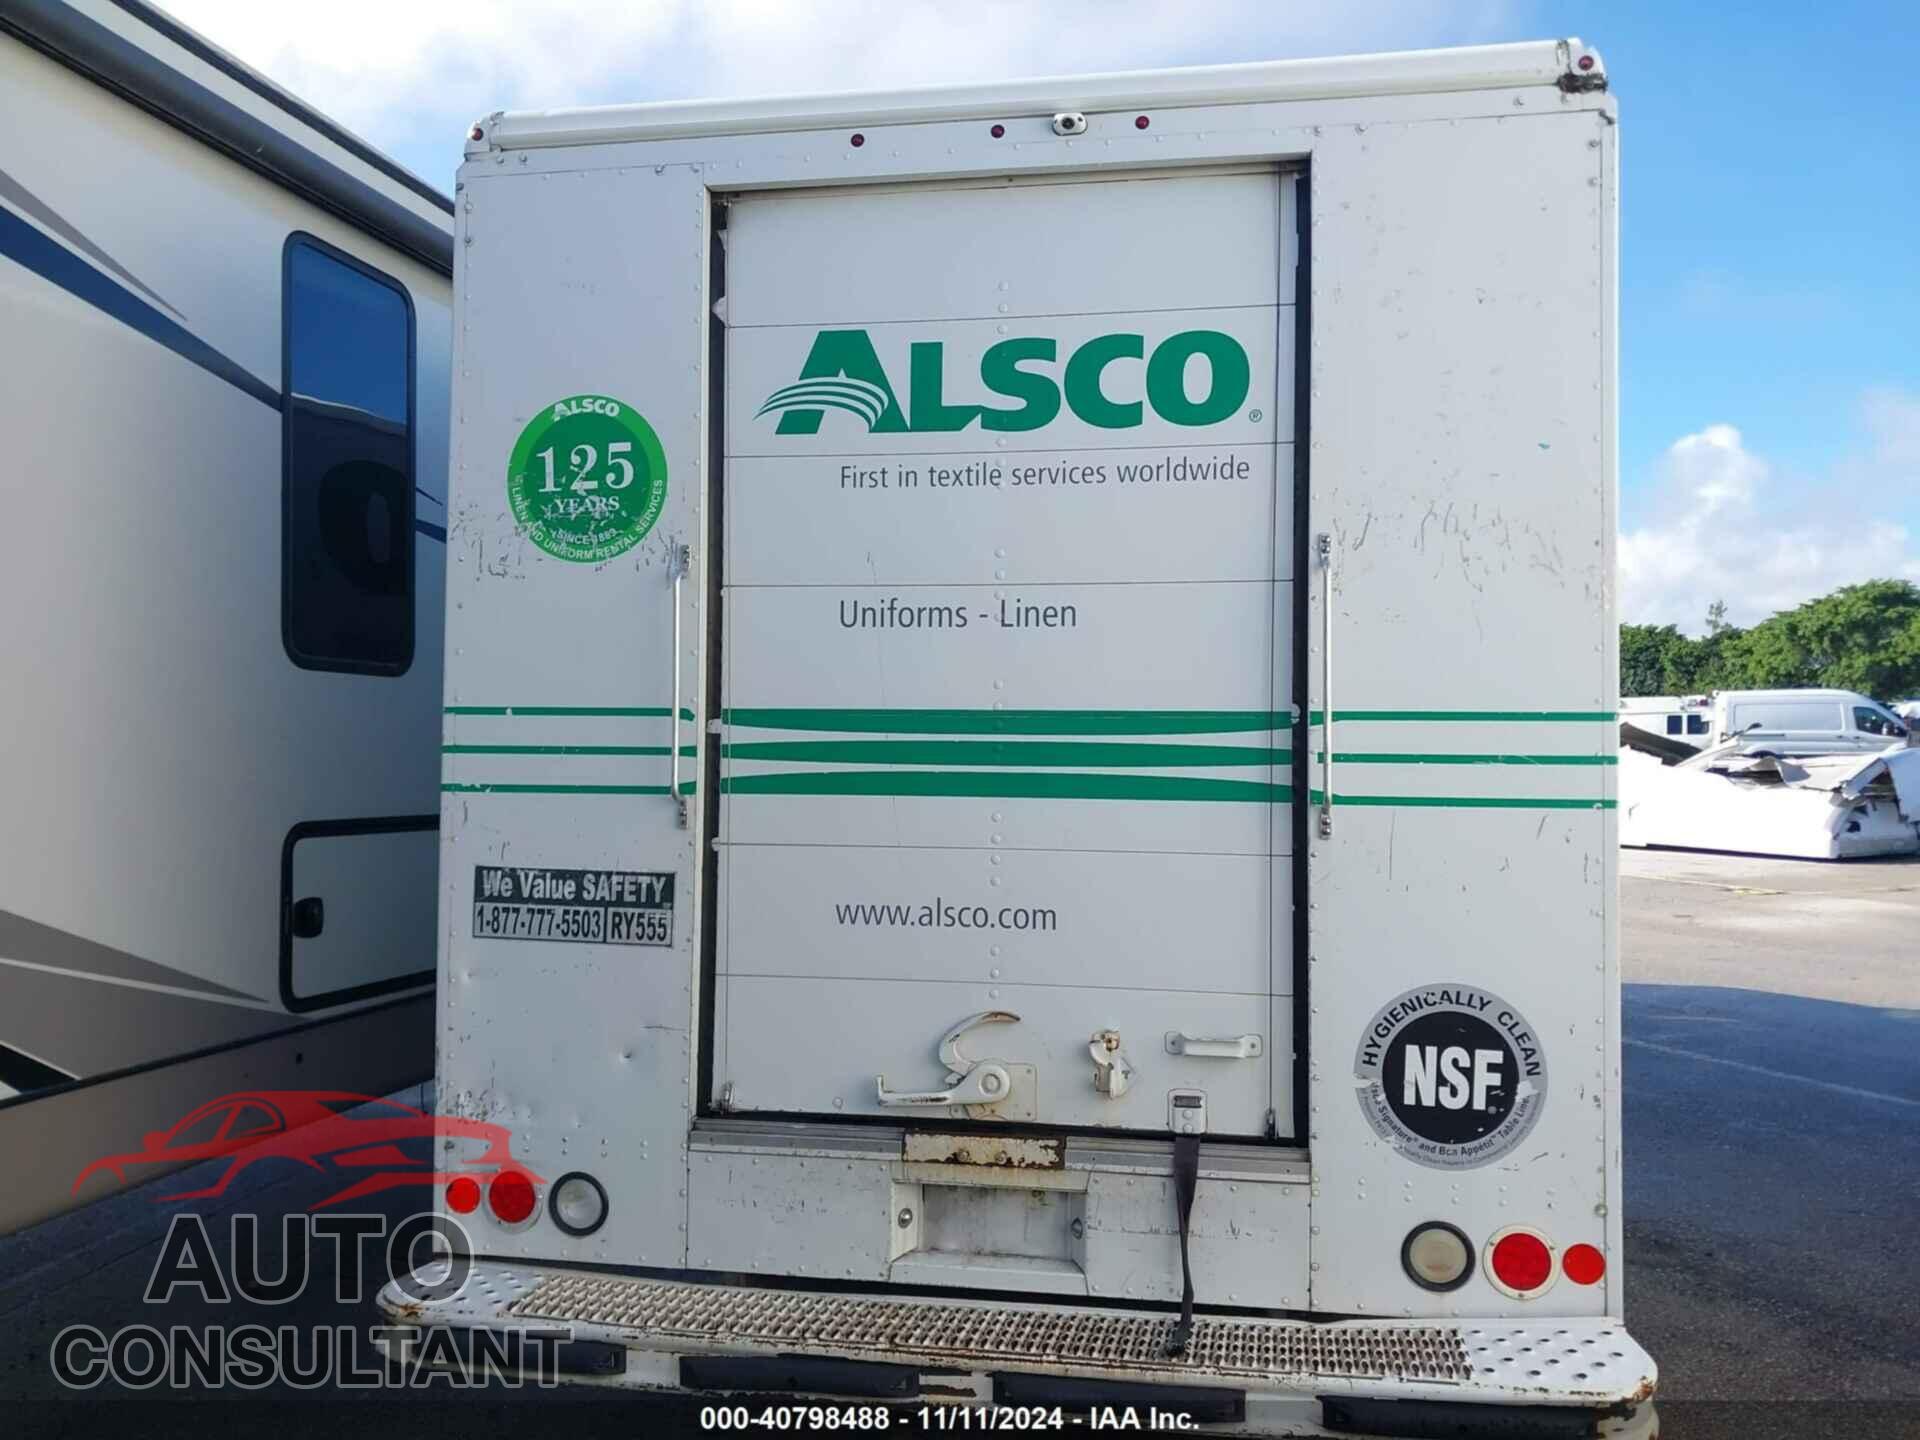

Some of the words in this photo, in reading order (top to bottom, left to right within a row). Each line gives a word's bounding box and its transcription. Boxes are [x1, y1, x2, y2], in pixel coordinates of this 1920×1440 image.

[552, 398, 619, 421] ALSCO
[536, 442, 634, 492] 125
[840, 464, 888, 490] First
[897, 464, 918, 488] in
[928, 460, 1002, 488] textile
[1010, 458, 1106, 486] services
[1116, 454, 1250, 483] worldwide
[555, 496, 620, 513] YEARS
[635, 480, 663, 534] SERVICES
[839, 597, 968, 628] Uniforms
[1000, 598, 1077, 628] Linen
[482, 869, 513, 897] We
[519, 871, 576, 900] Value
[582, 873, 666, 903] SAFETY
[476, 904, 601, 937] 1-877-777-5503
[611, 911, 667, 942] RY555
[836, 897, 1057, 930] www.alsco.com
[1362, 990, 1493, 1067] HYGIENICALLY
[1497, 1011, 1541, 1077] CLEAN
